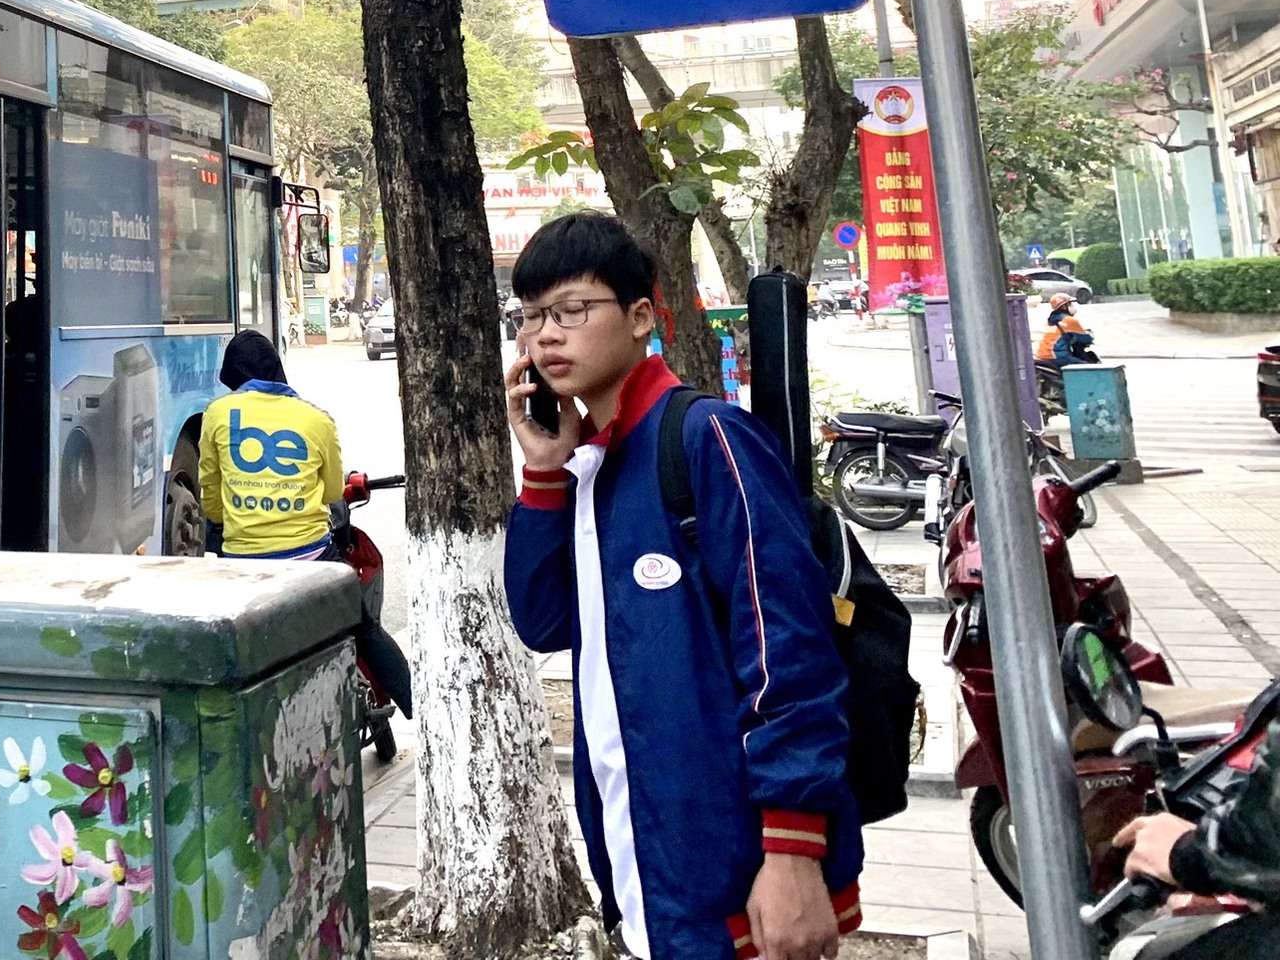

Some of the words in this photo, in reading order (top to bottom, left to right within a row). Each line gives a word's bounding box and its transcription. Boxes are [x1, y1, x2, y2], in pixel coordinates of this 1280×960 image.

[885, 147, 911, 167] ĐẢNG
[875, 175, 902, 192] CỘNG
[904, 171, 922, 190] SẢN
[880, 199, 899, 216] VIỆT
[901, 199, 922, 213] NAM
[111, 211, 151, 240] Funiki
[875, 222, 907, 238] QUANG
[909, 222, 930, 237] VINH
[876, 244, 906, 261] MUÔN
[230, 408, 308, 476] be
